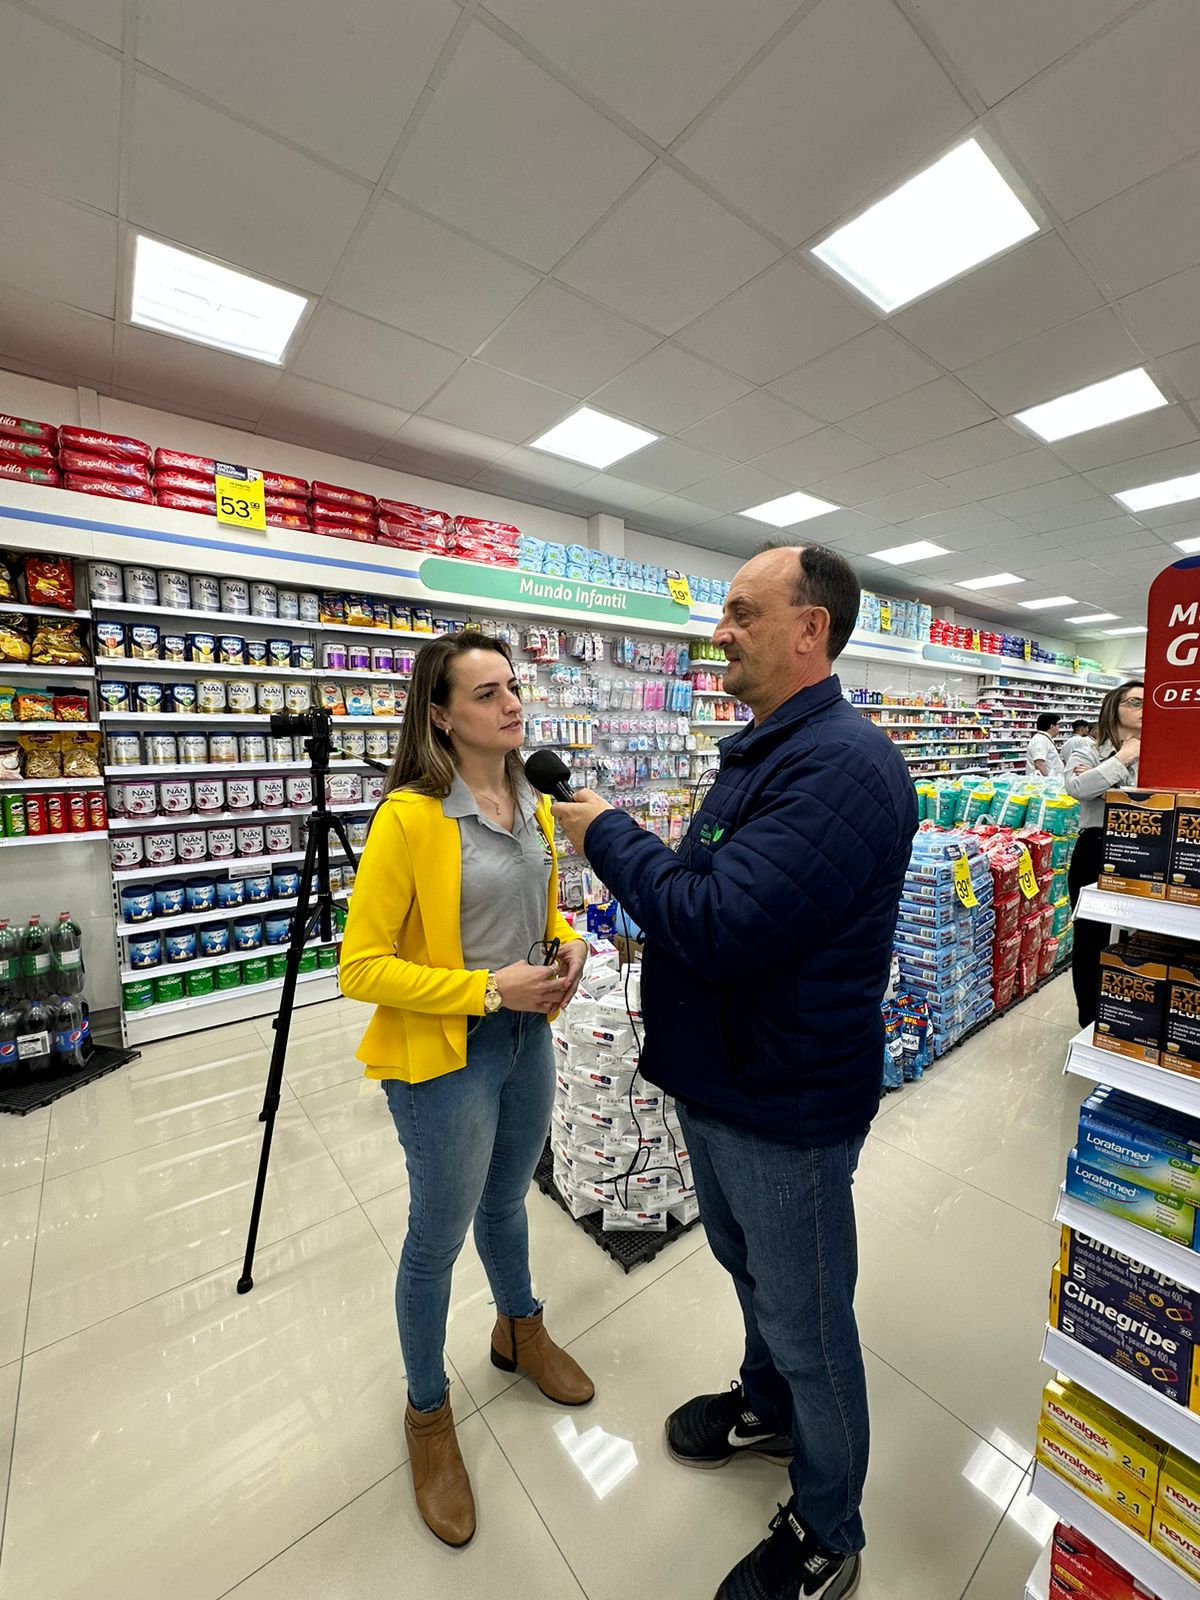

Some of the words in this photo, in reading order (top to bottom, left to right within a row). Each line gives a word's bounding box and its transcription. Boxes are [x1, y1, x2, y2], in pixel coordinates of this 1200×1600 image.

[94, 569, 118, 579] NAN
[133, 573, 155, 583] NAN
[167, 577, 188, 587] NAN
[199, 582, 218, 592] NAN
[226, 585, 246, 594] NAN
[257, 588, 277, 597] NAN
[519, 578, 572, 602] Mundo
[576, 588, 627, 609] Infantil
[1168, 602, 1200, 627] M
[1108, 810, 1163, 826] EXPEC
[1106, 830, 1138, 839] PLUS
[1107, 822, 1161, 836] PULMON
[113, 841, 135, 849] NAN
[957, 880, 968, 899] 39
[1020, 873, 1031, 892] 79
[1103, 972, 1155, 994] EXPEC
[1100, 991, 1132, 1003] PLUS
[1101, 983, 1155, 1003] PULMON
[1086, 1133, 1150, 1162] Loratamed
[1130, 1158, 1140, 1166] mg
[1075, 1165, 1137, 1197] Loratamed
[1117, 1192, 1127, 1200] mg
[1073, 1262, 1087, 1280] 5
[1171, 1290, 1183, 1304] 400
[1062, 1316, 1075, 1333] 5
[1063, 1281, 1177, 1354] Cimegripe
[1180, 1327, 1192, 1337] 20
[1157, 1350, 1169, 1364] 400
[1166, 1388, 1177, 1398] 20
[1048, 1401, 1109, 1449] nevralgex
[1042, 1436, 1103, 1485] nevralgex
[1055, 1545, 1093, 1576] Doralgina
